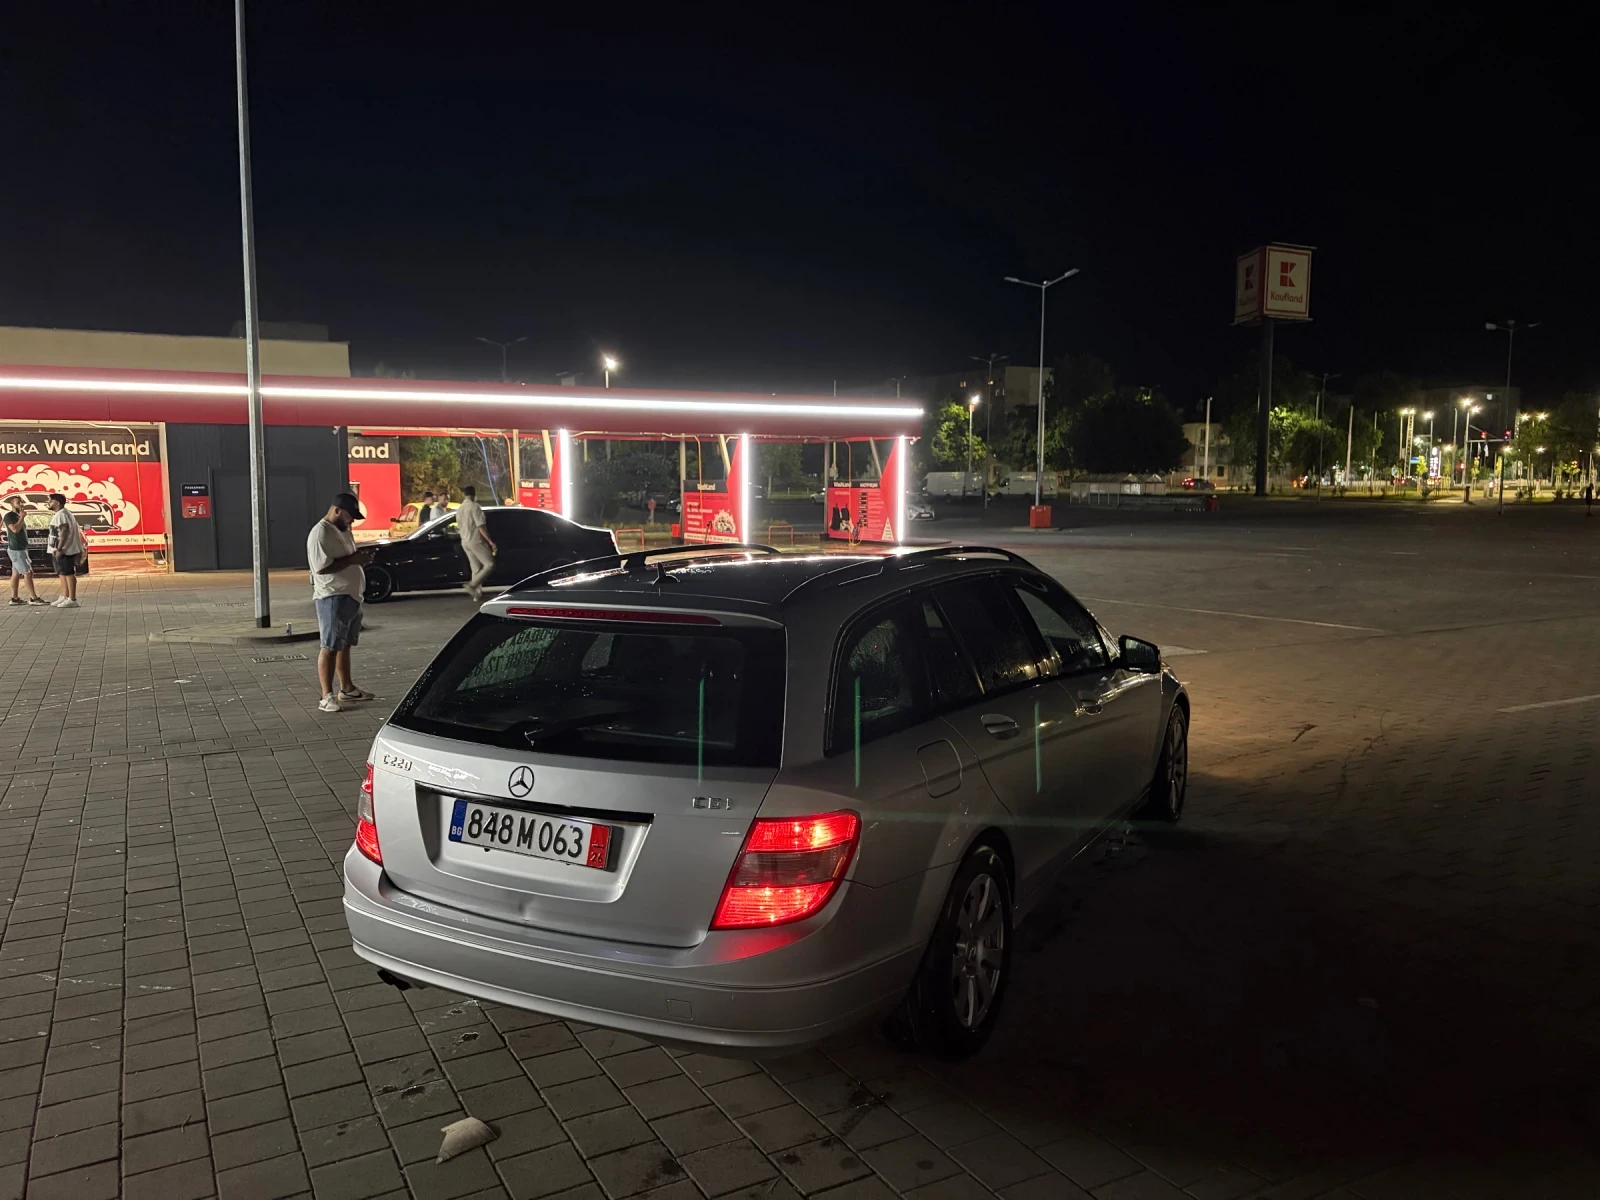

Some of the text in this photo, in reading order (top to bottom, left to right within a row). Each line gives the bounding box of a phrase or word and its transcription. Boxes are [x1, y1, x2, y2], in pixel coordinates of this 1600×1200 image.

[1270, 291, 1303, 303] Kaufland
[44, 439, 150, 456] WashLand
[348, 443, 389, 458] and
[451, 825, 463, 836] BG
